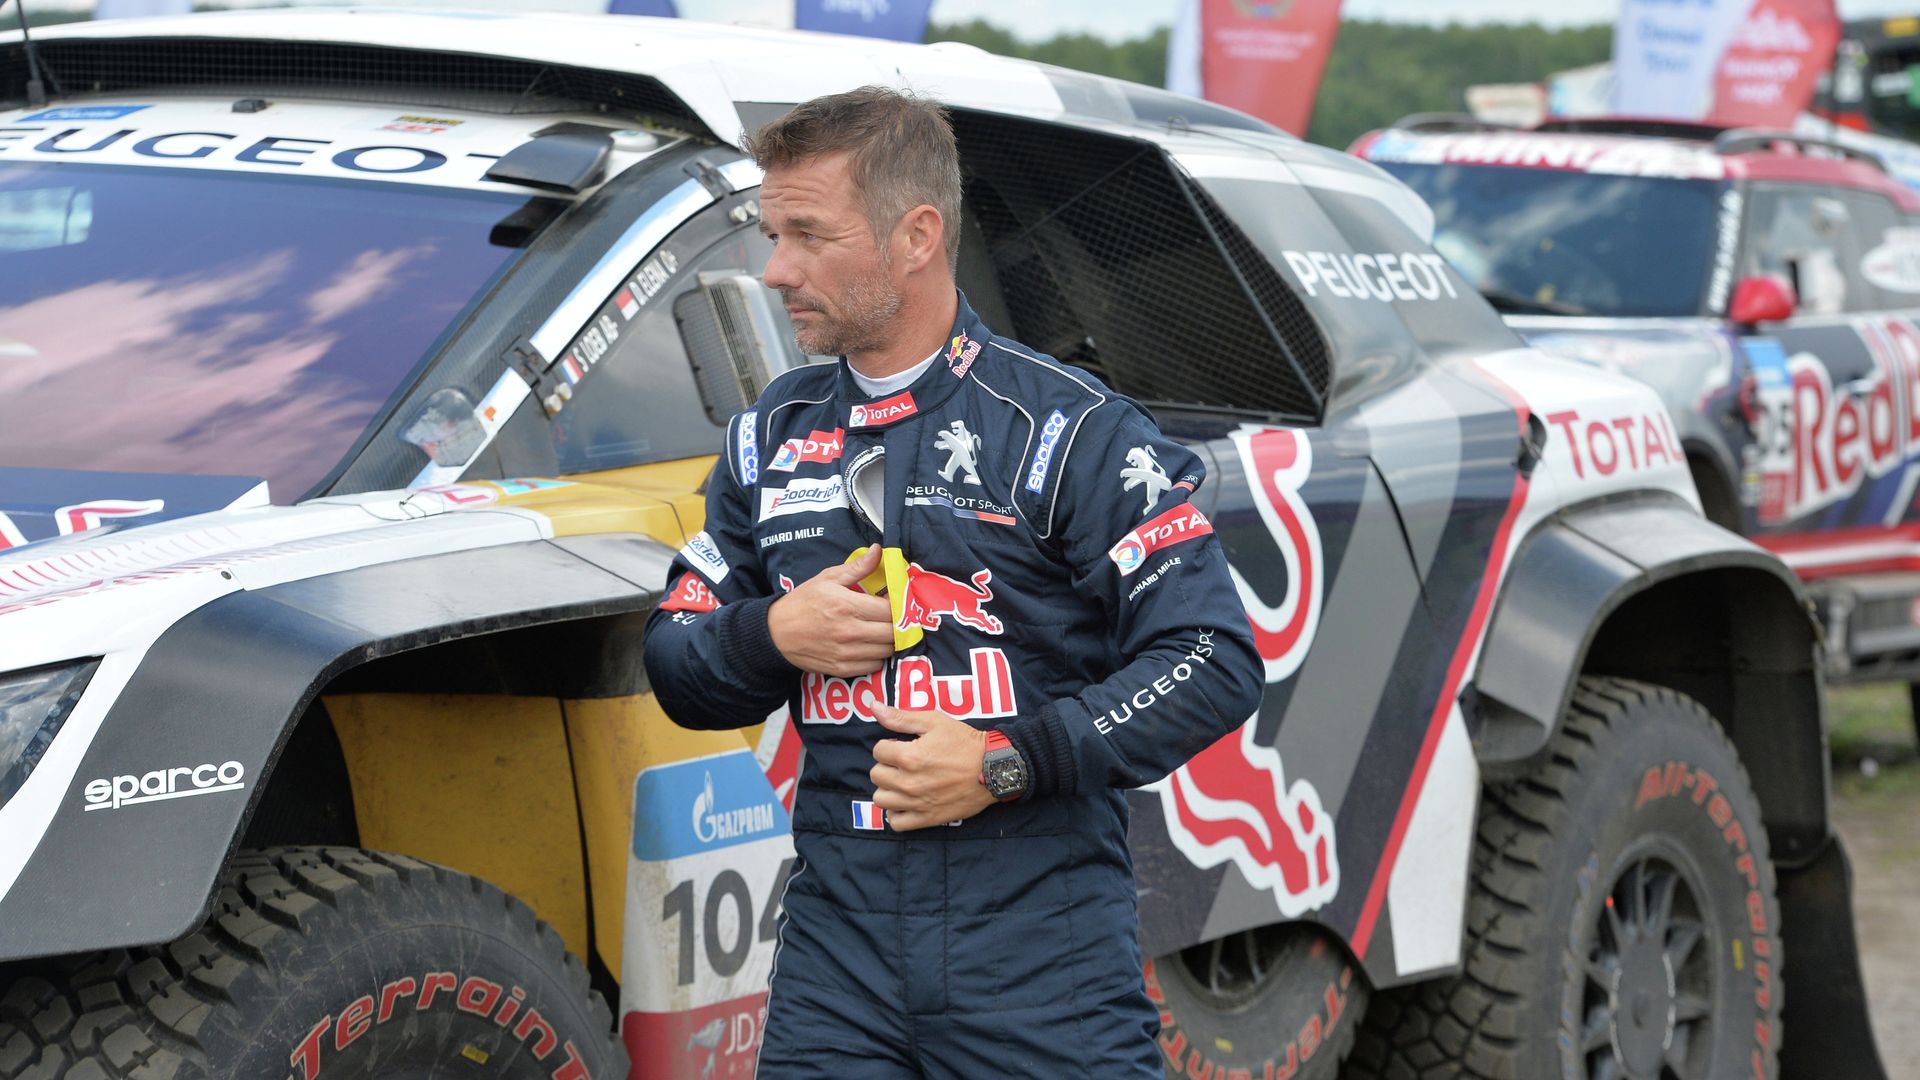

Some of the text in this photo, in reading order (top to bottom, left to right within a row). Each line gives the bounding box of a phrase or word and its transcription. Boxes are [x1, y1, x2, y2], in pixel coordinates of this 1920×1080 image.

[1281, 250, 1458, 302] PEUGEOT
[868, 402, 912, 420] TOTAL
[1028, 412, 1065, 492] sparco
[1547, 410, 1683, 480] TOTAL
[906, 485, 1013, 515] PEUGEOT SPORT
[760, 526, 825, 548] RICHARD MILLE
[1160, 557, 1182, 576] MILLE
[803, 650, 1014, 722] Red Bull
[84, 761, 244, 808] sparco
[717, 803, 774, 839] GAZPROM
